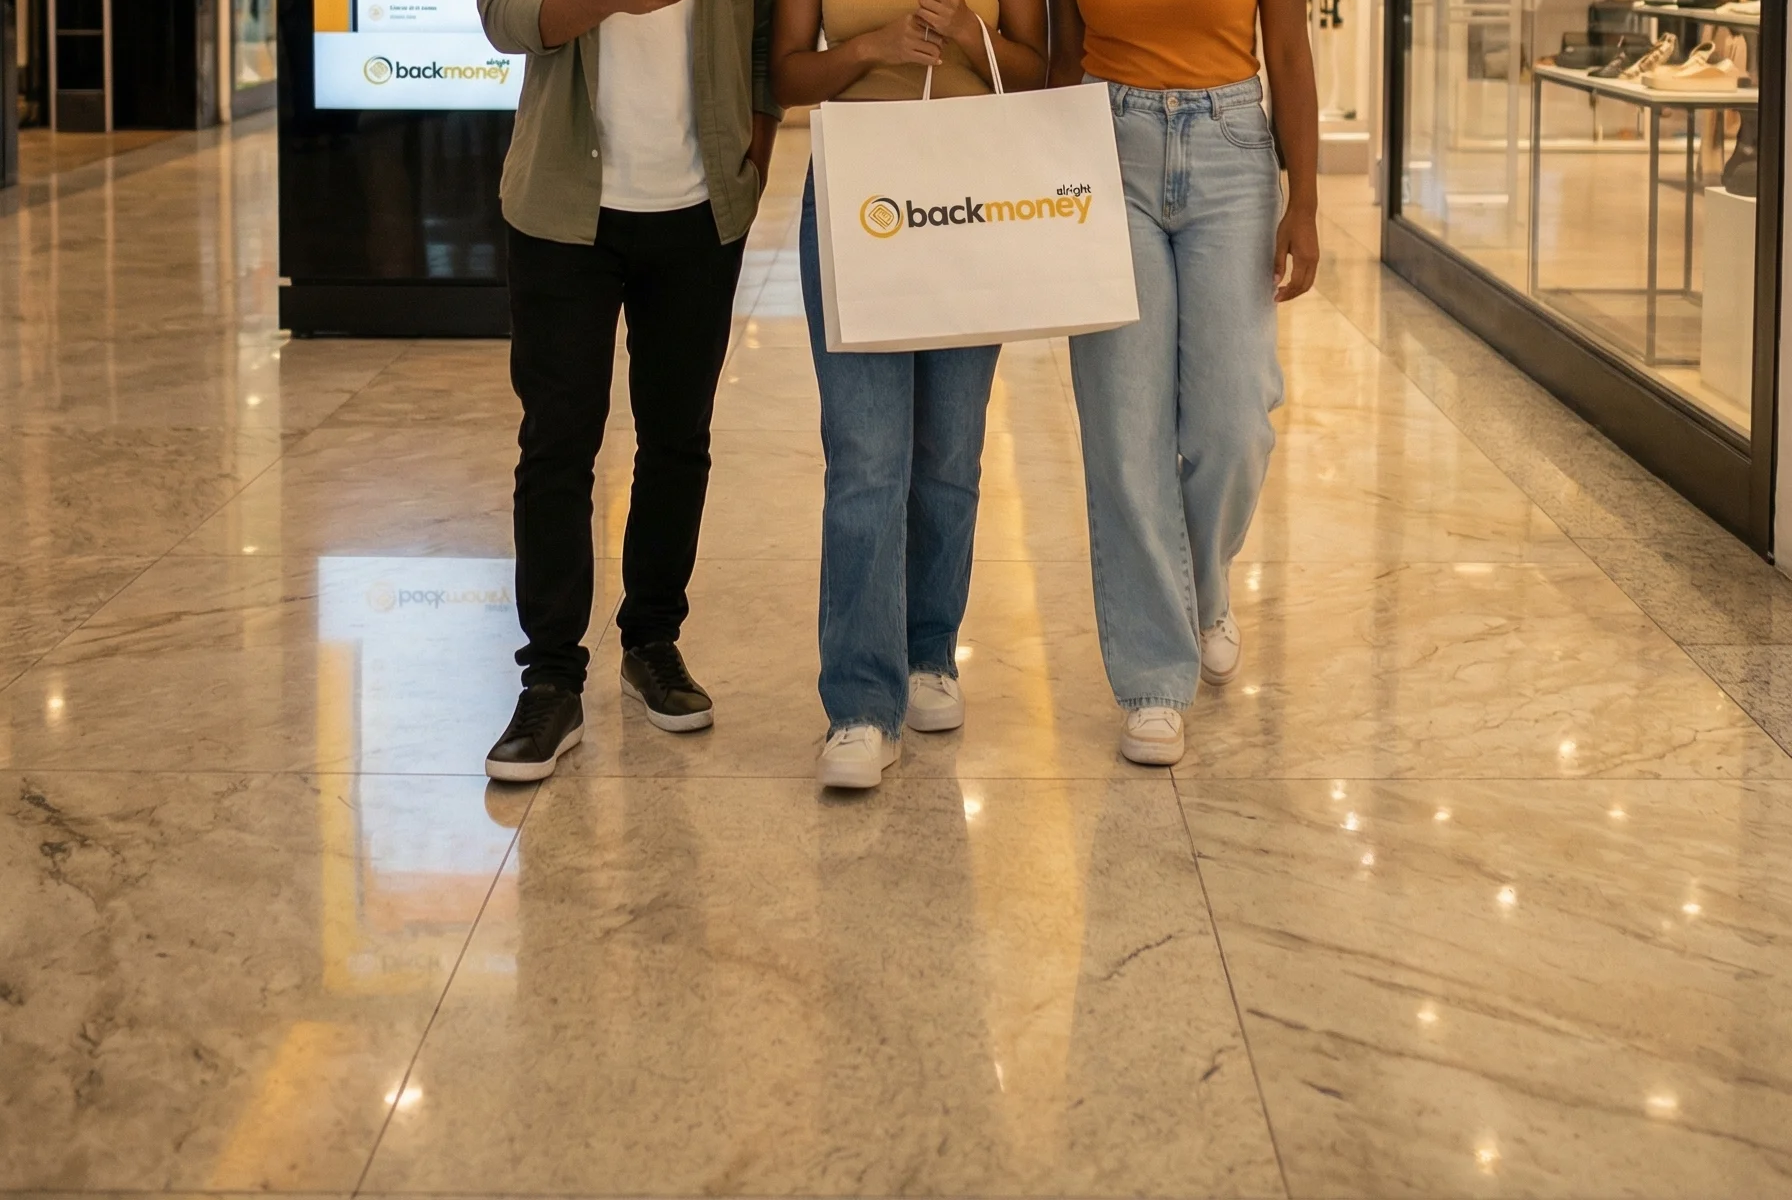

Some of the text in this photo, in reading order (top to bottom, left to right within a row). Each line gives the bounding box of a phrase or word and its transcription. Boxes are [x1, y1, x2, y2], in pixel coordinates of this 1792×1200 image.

[395, 61, 510, 85] backmoney
[1056, 183, 1092, 197] alright
[905, 196, 1092, 228] backmoney
